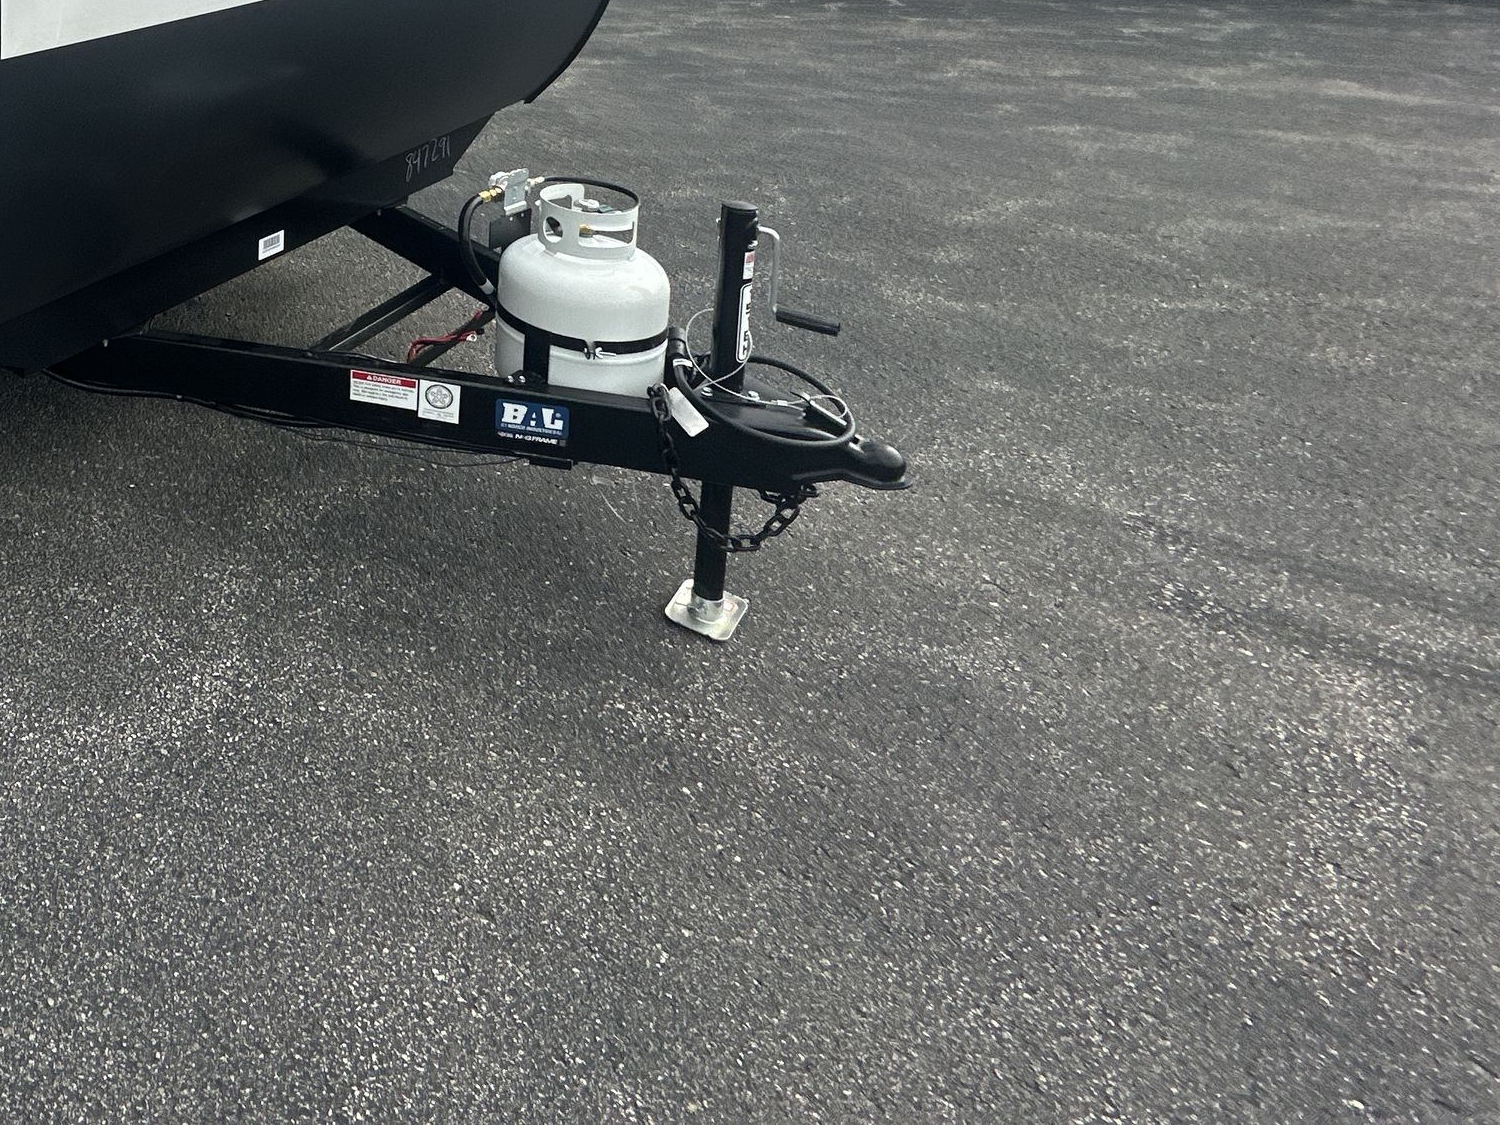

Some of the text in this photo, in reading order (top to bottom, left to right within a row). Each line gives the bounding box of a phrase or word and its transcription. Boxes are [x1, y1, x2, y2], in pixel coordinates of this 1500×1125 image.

[405, 135, 451, 182] 847291
[372, 375, 402, 386] DANGER
[501, 402, 564, 430] BAL
